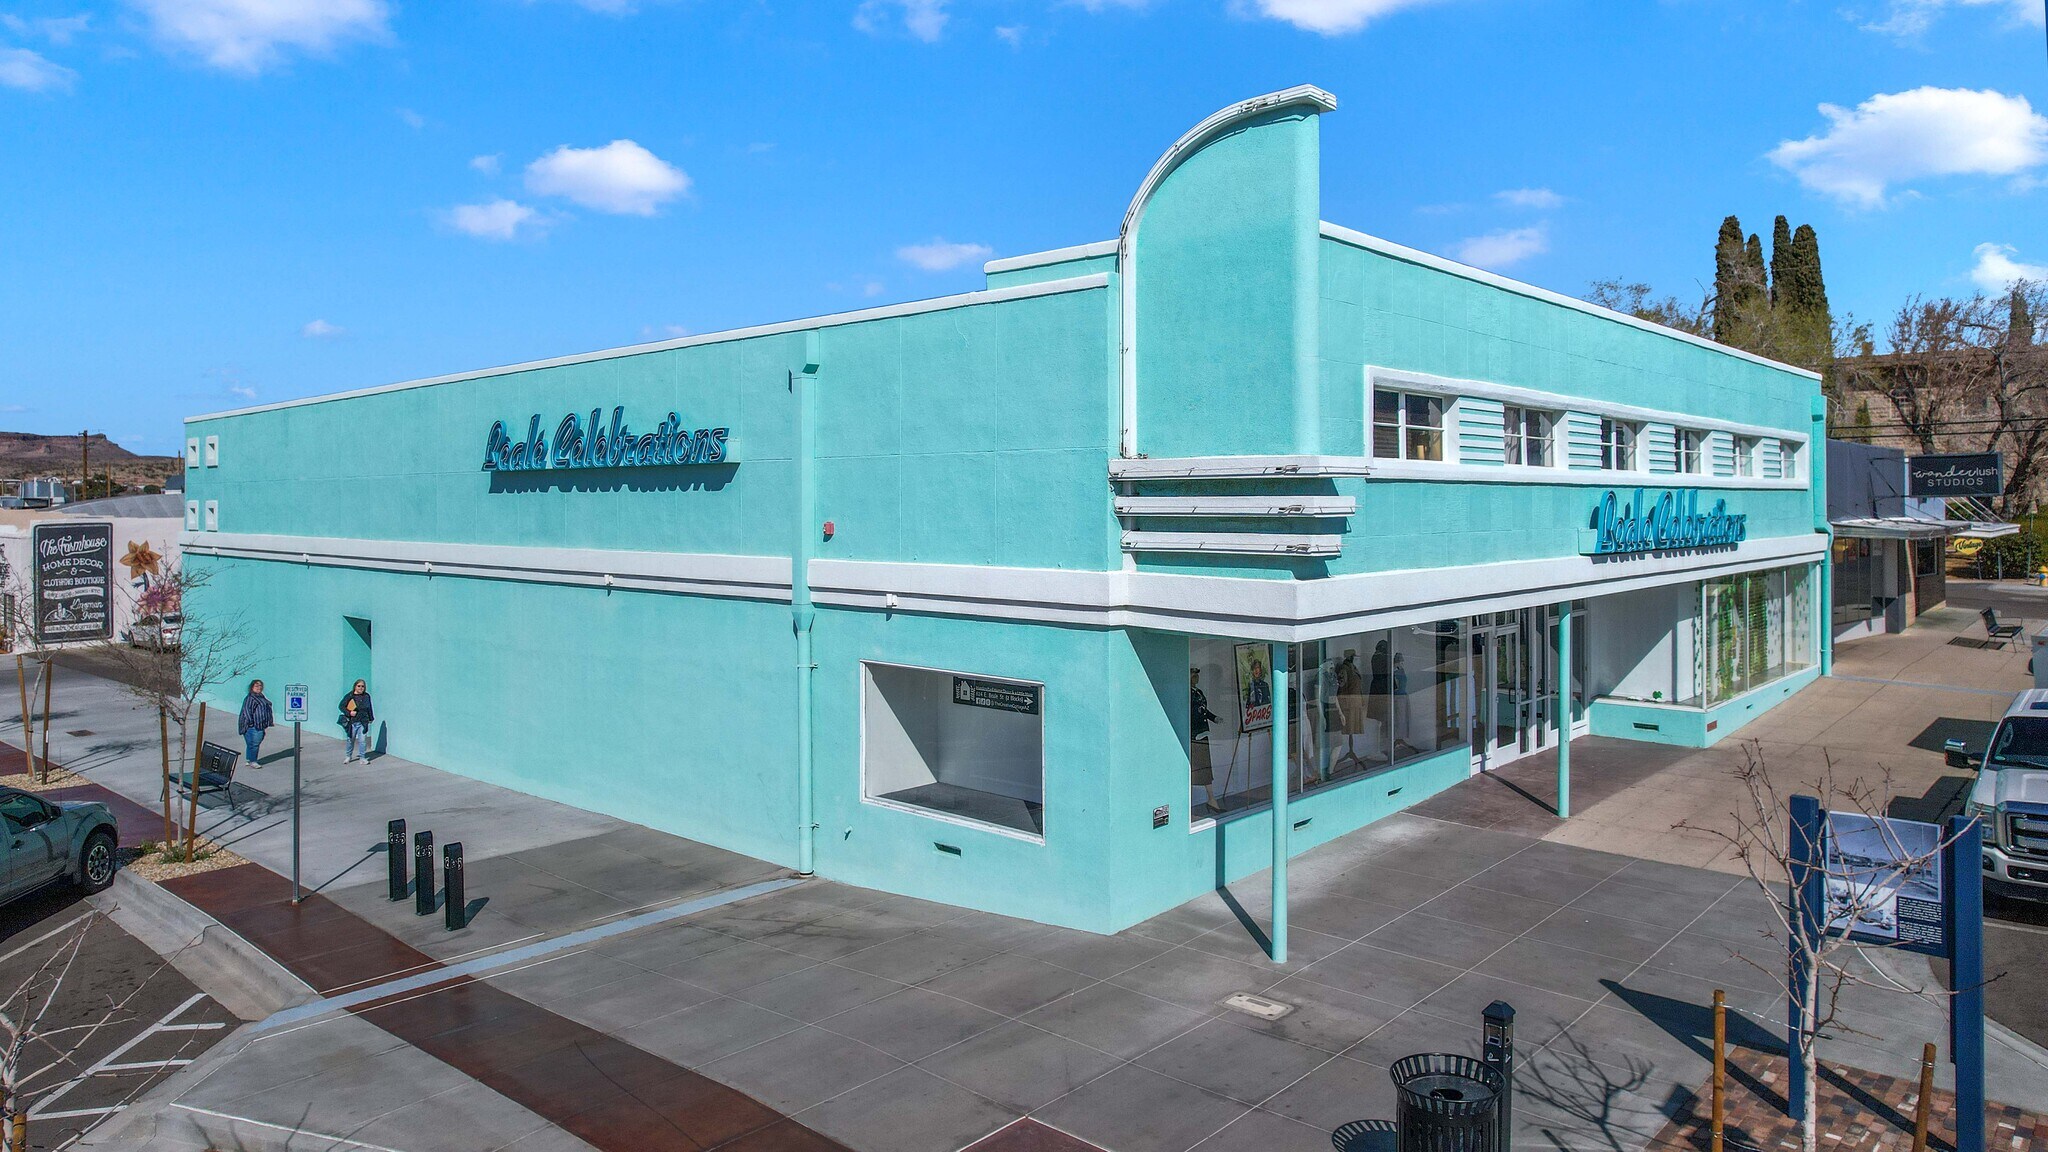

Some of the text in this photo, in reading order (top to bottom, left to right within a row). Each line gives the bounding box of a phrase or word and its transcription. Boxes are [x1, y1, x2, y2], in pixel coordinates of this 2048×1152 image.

[550, 405, 730, 470] Celebrations
[1913, 465, 1998, 479] wanderlush
[1927, 477, 1984, 487] STUDIOS
[40, 534, 107, 558] The Farmhouse
[42, 557, 104, 572] HOME DECOR
[70, 567, 77, 575] &
[43, 576, 105, 587] CLOTHING BOUTIQUE
